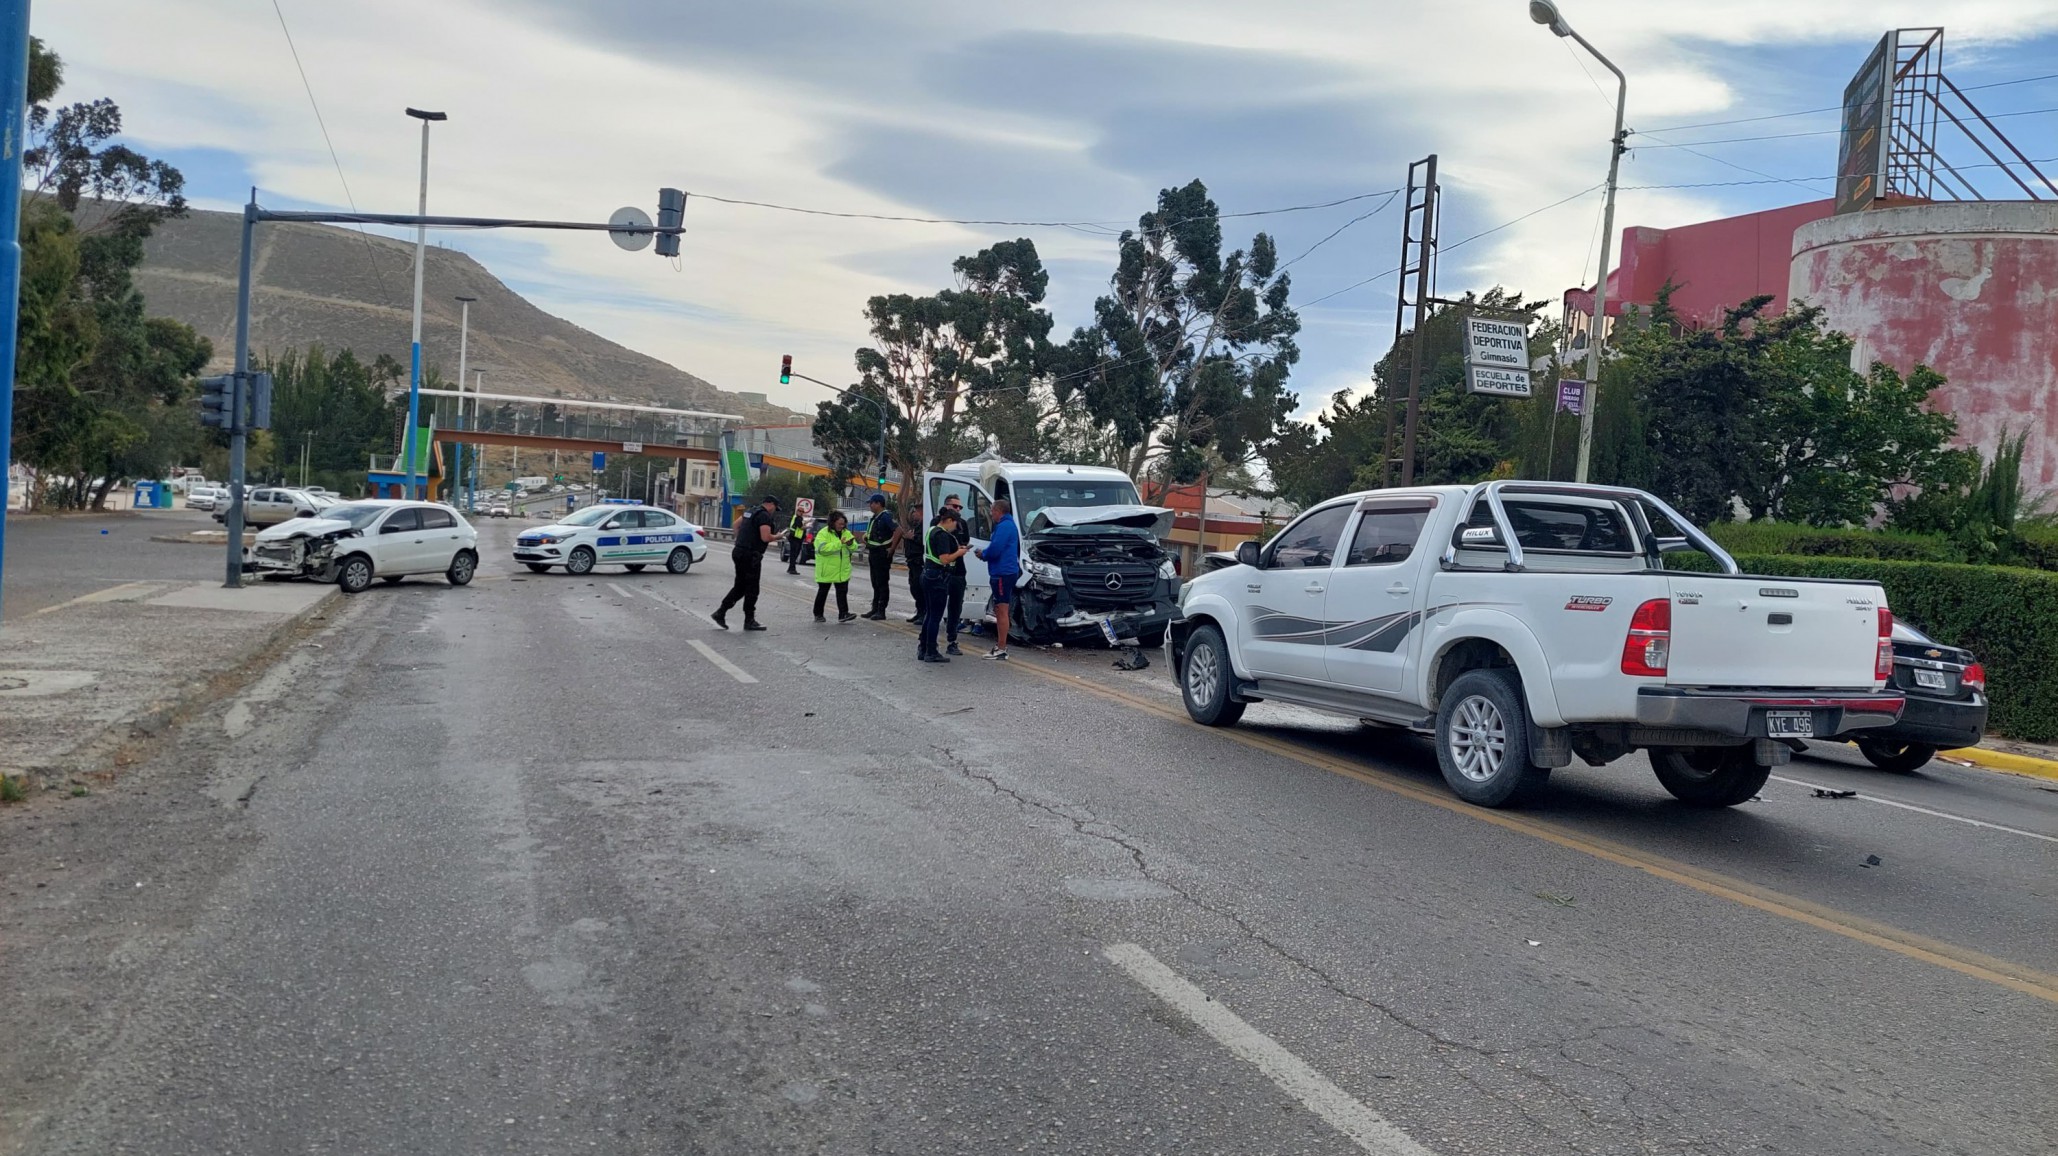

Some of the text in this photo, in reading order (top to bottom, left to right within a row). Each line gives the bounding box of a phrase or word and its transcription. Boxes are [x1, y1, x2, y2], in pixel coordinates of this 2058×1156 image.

[1472, 322, 1522, 337] FEDERACION
[1473, 336, 1523, 351] DEPORTIVA
[1480, 351, 1518, 364] Gimnasio
[1476, 370, 1525, 383] ESCUELA de
[1477, 380, 1528, 393] DEPORTES
[1563, 387, 1581, 396] CLUB
[644, 536, 673, 544] POLICIA
[1570, 596, 1613, 605] TURBO
[1769, 717, 1812, 733] KYE 496
